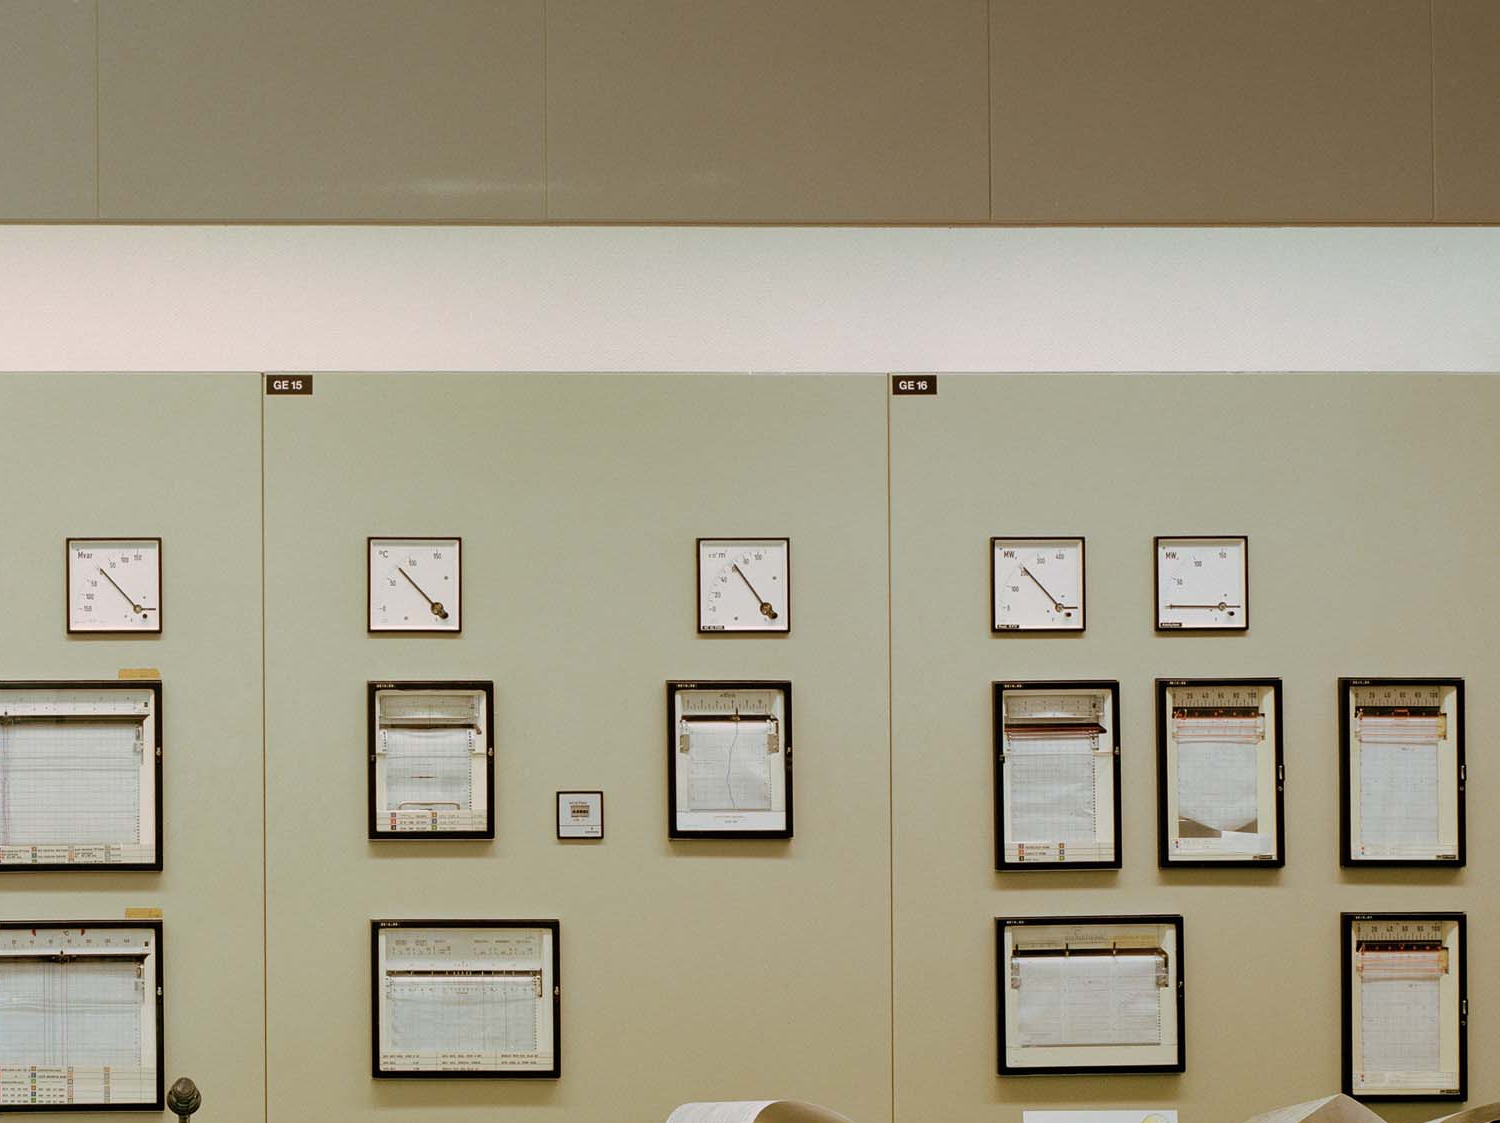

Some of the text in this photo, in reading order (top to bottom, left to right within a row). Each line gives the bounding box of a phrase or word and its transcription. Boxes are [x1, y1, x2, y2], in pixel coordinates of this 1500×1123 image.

[273, 381, 302, 390] GE 15
[899, 381, 927, 390] GE 16
[78, 551, 93, 559] Mvar
[379, 550, 389, 558] °C
